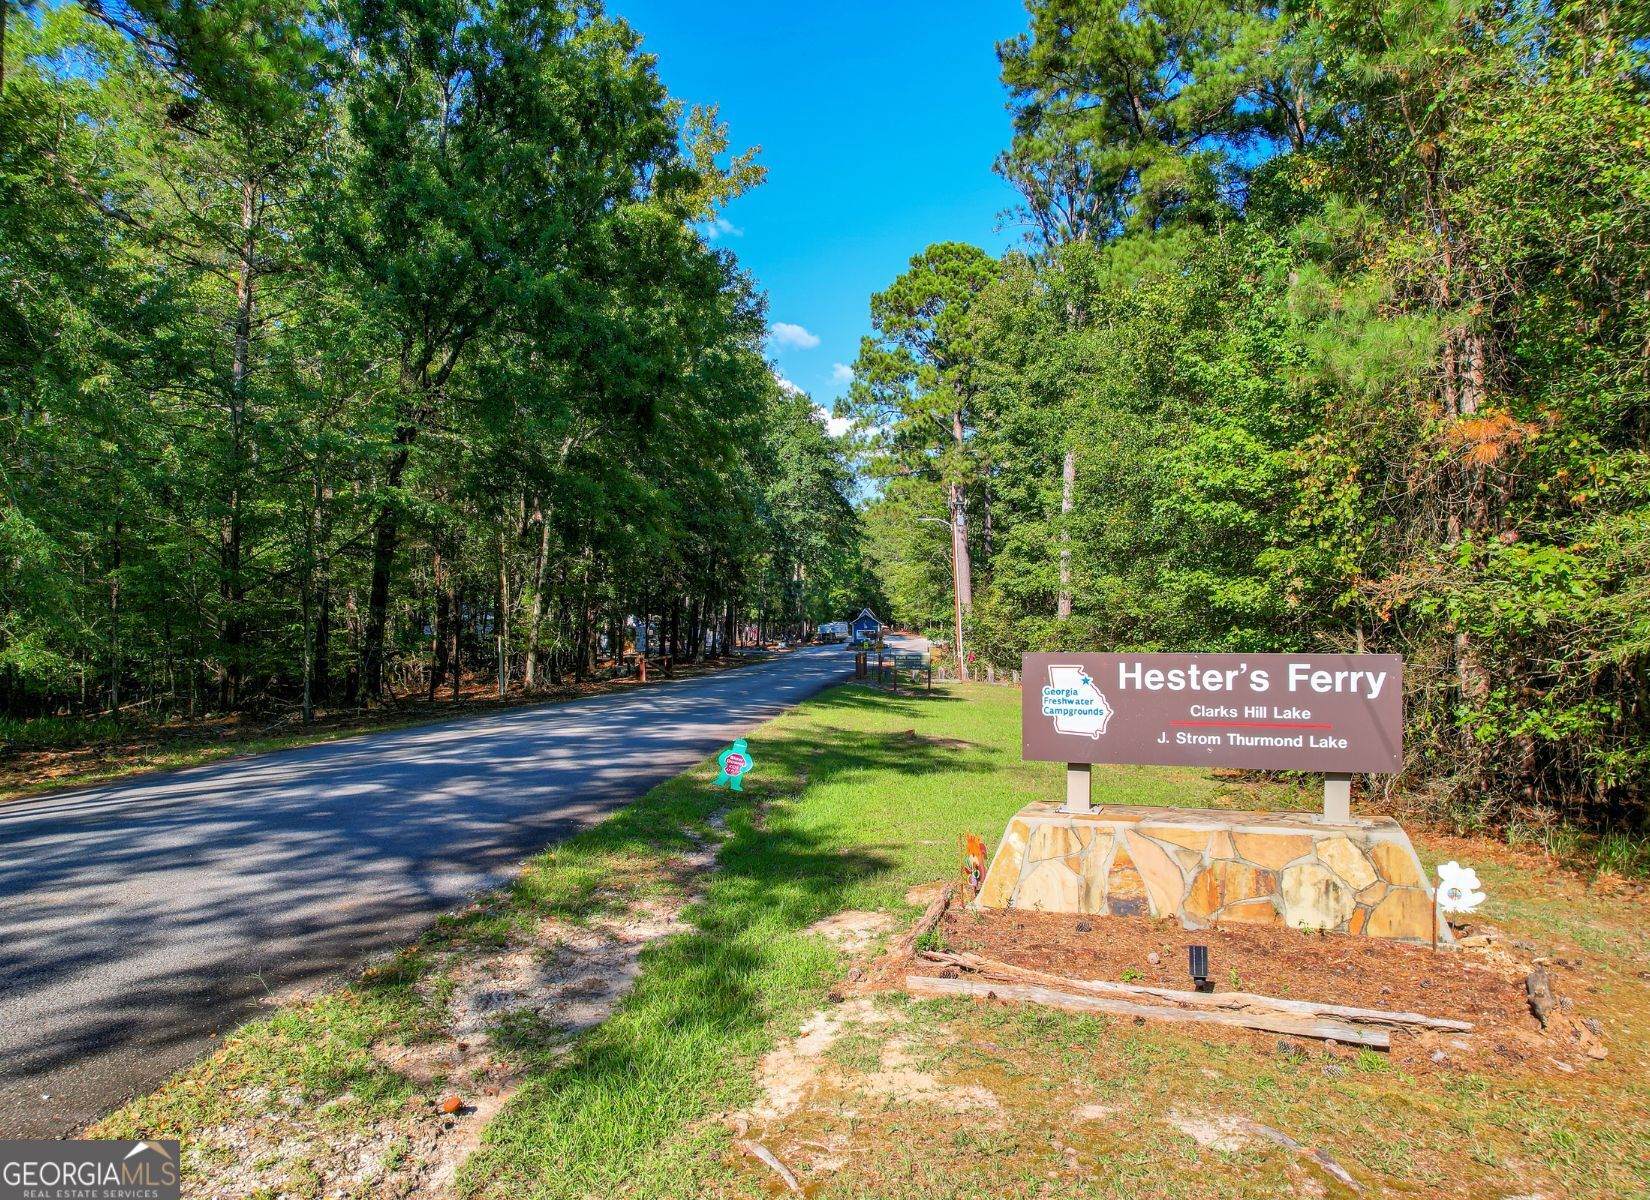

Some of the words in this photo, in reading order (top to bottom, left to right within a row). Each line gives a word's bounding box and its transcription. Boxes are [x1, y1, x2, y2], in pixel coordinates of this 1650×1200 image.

[1119, 662, 1270, 692] Hester’s
[1288, 663, 1387, 699] Ferry
[1043, 687, 1078, 697] Georgia
[1043, 697, 1094, 705] Freshwater
[1043, 706, 1104, 717] Campgrounds
[1190, 704, 1238, 718] Clarks
[1244, 706, 1267, 719] Hill
[1273, 706, 1311, 720] Lake
[1157, 731, 1170, 744] J.
[1176, 731, 1221, 745] Strom
[1226, 733, 1303, 748] Thurmond
[1309, 735, 1348, 749] Lake
